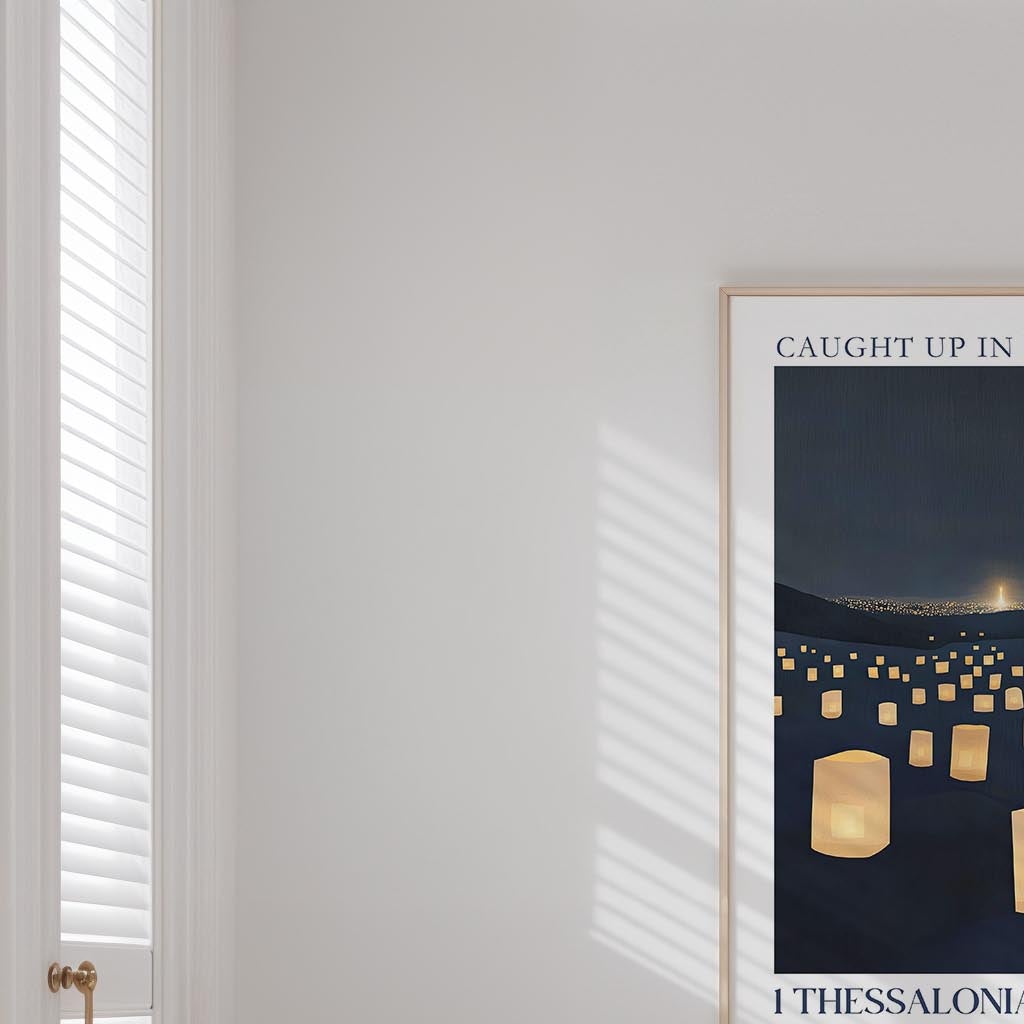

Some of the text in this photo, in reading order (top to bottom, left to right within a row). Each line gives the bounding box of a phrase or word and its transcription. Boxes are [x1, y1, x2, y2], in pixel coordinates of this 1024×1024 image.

[776, 336, 914, 359] CAUGHT
[925, 336, 965, 359] UP
[978, 336, 1012, 359] IN
[774, 988, 783, 1015] 1
